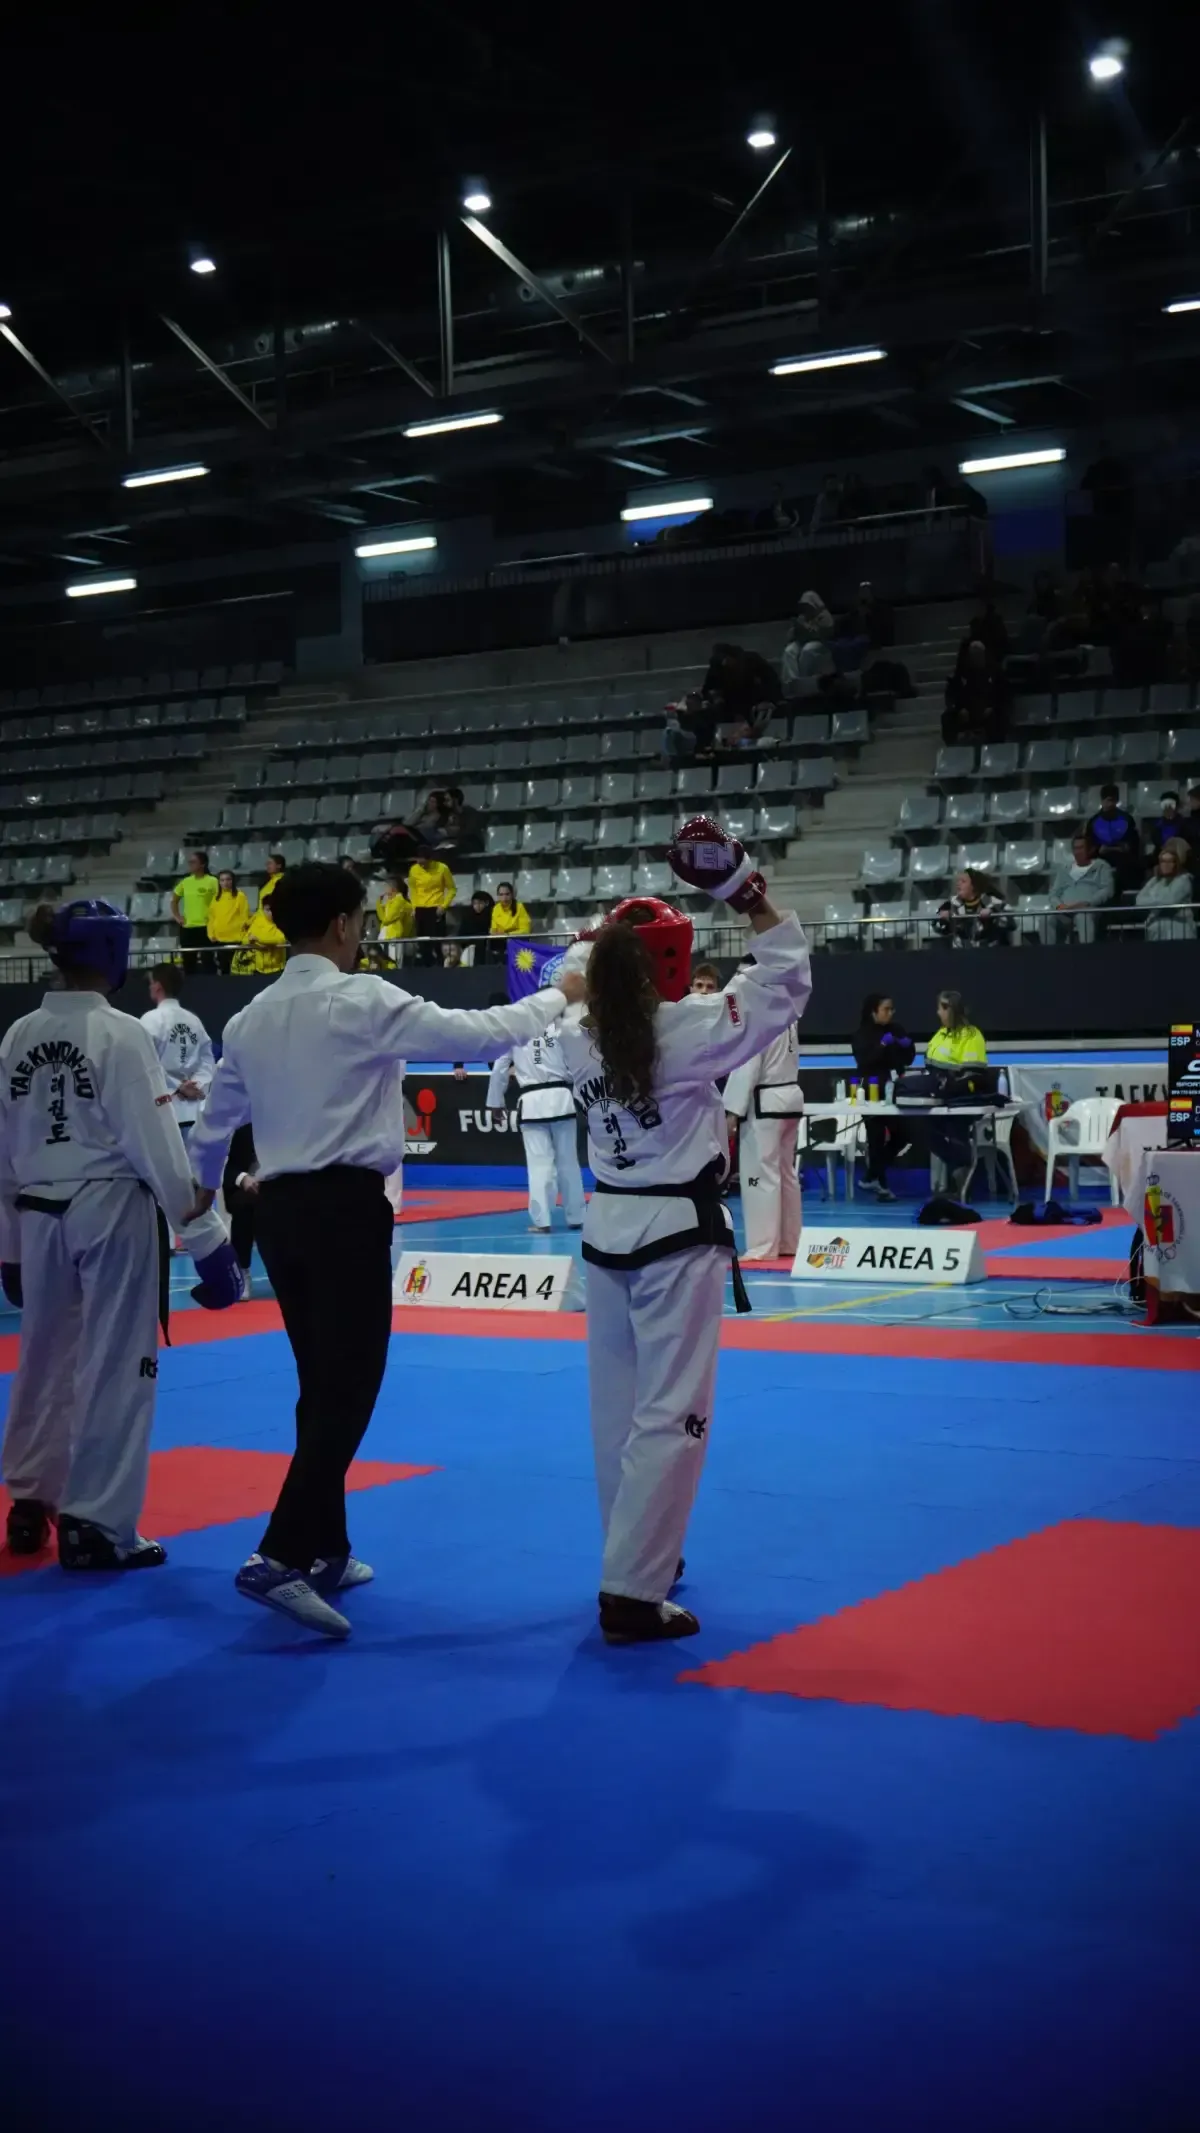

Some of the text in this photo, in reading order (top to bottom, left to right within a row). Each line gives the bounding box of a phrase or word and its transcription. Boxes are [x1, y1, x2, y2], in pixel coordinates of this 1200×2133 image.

[1170, 1036, 1191, 1046] ESP
[1169, 1112, 1190, 1123] ESP
[856, 1245, 961, 1271] AREA 5
[451, 1271, 555, 1300] AREA 4
